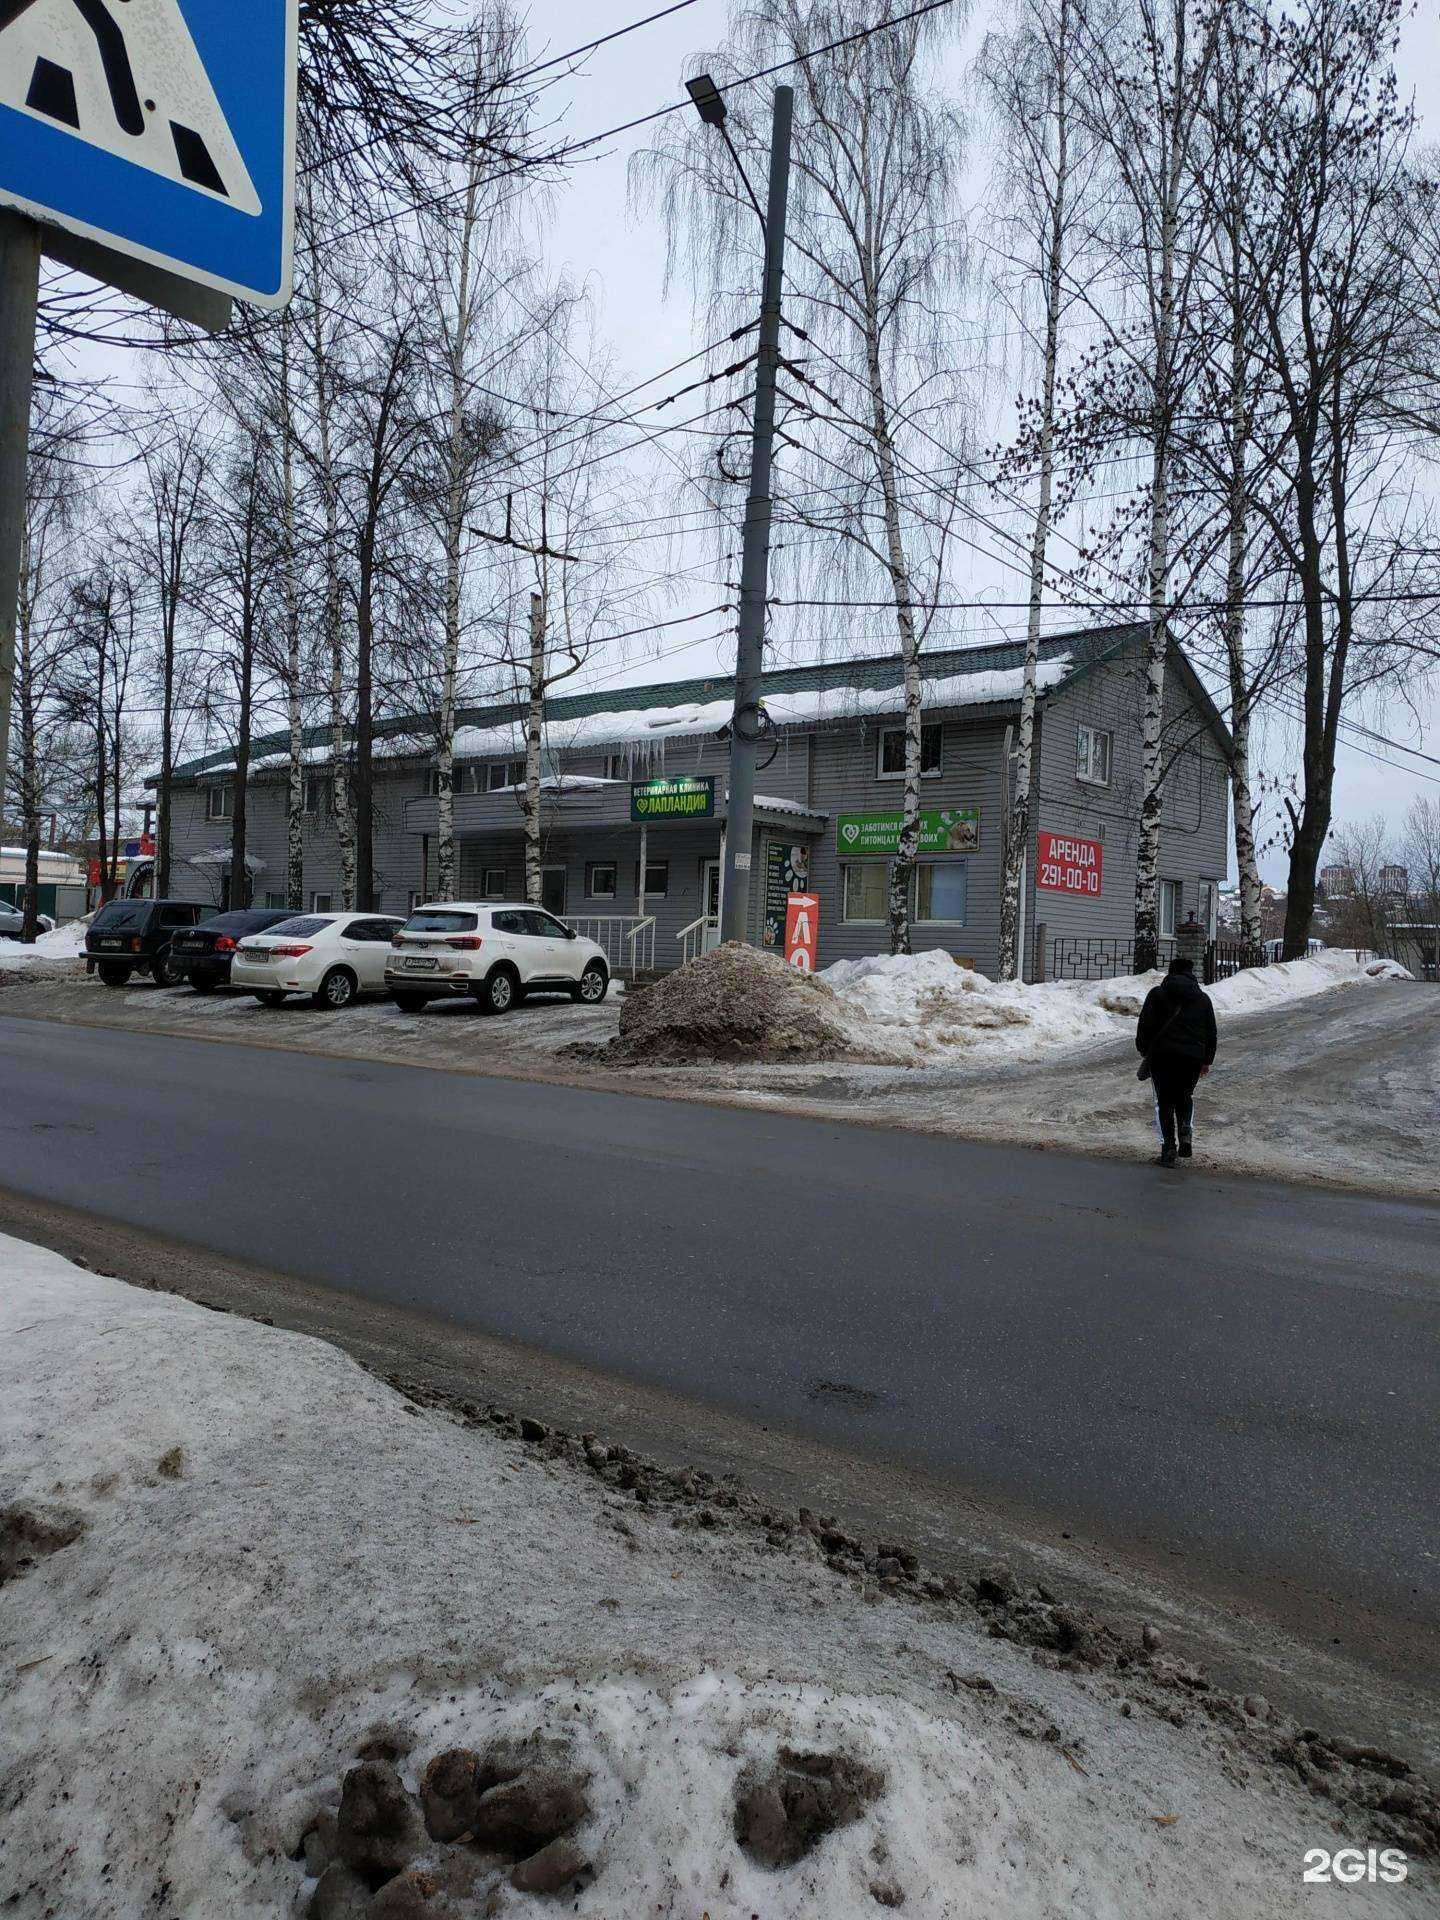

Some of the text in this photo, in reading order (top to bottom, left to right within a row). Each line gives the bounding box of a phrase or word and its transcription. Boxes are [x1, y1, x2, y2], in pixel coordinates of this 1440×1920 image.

[634, 781, 710, 797] ВЕТЕРИНАРНАЯ КЛИНИКА
[647, 793, 707, 814] ЛАПЛАНДИЯ
[860, 820, 898, 833] ЗАБОТИМСЯ
[860, 833, 896, 846] ПИТОМЦАХ
[917, 832, 938, 844] ВОИХ
[1048, 838, 1096, 868] АРЕНДА
[1041, 863, 1099, 892] 291-00-10
